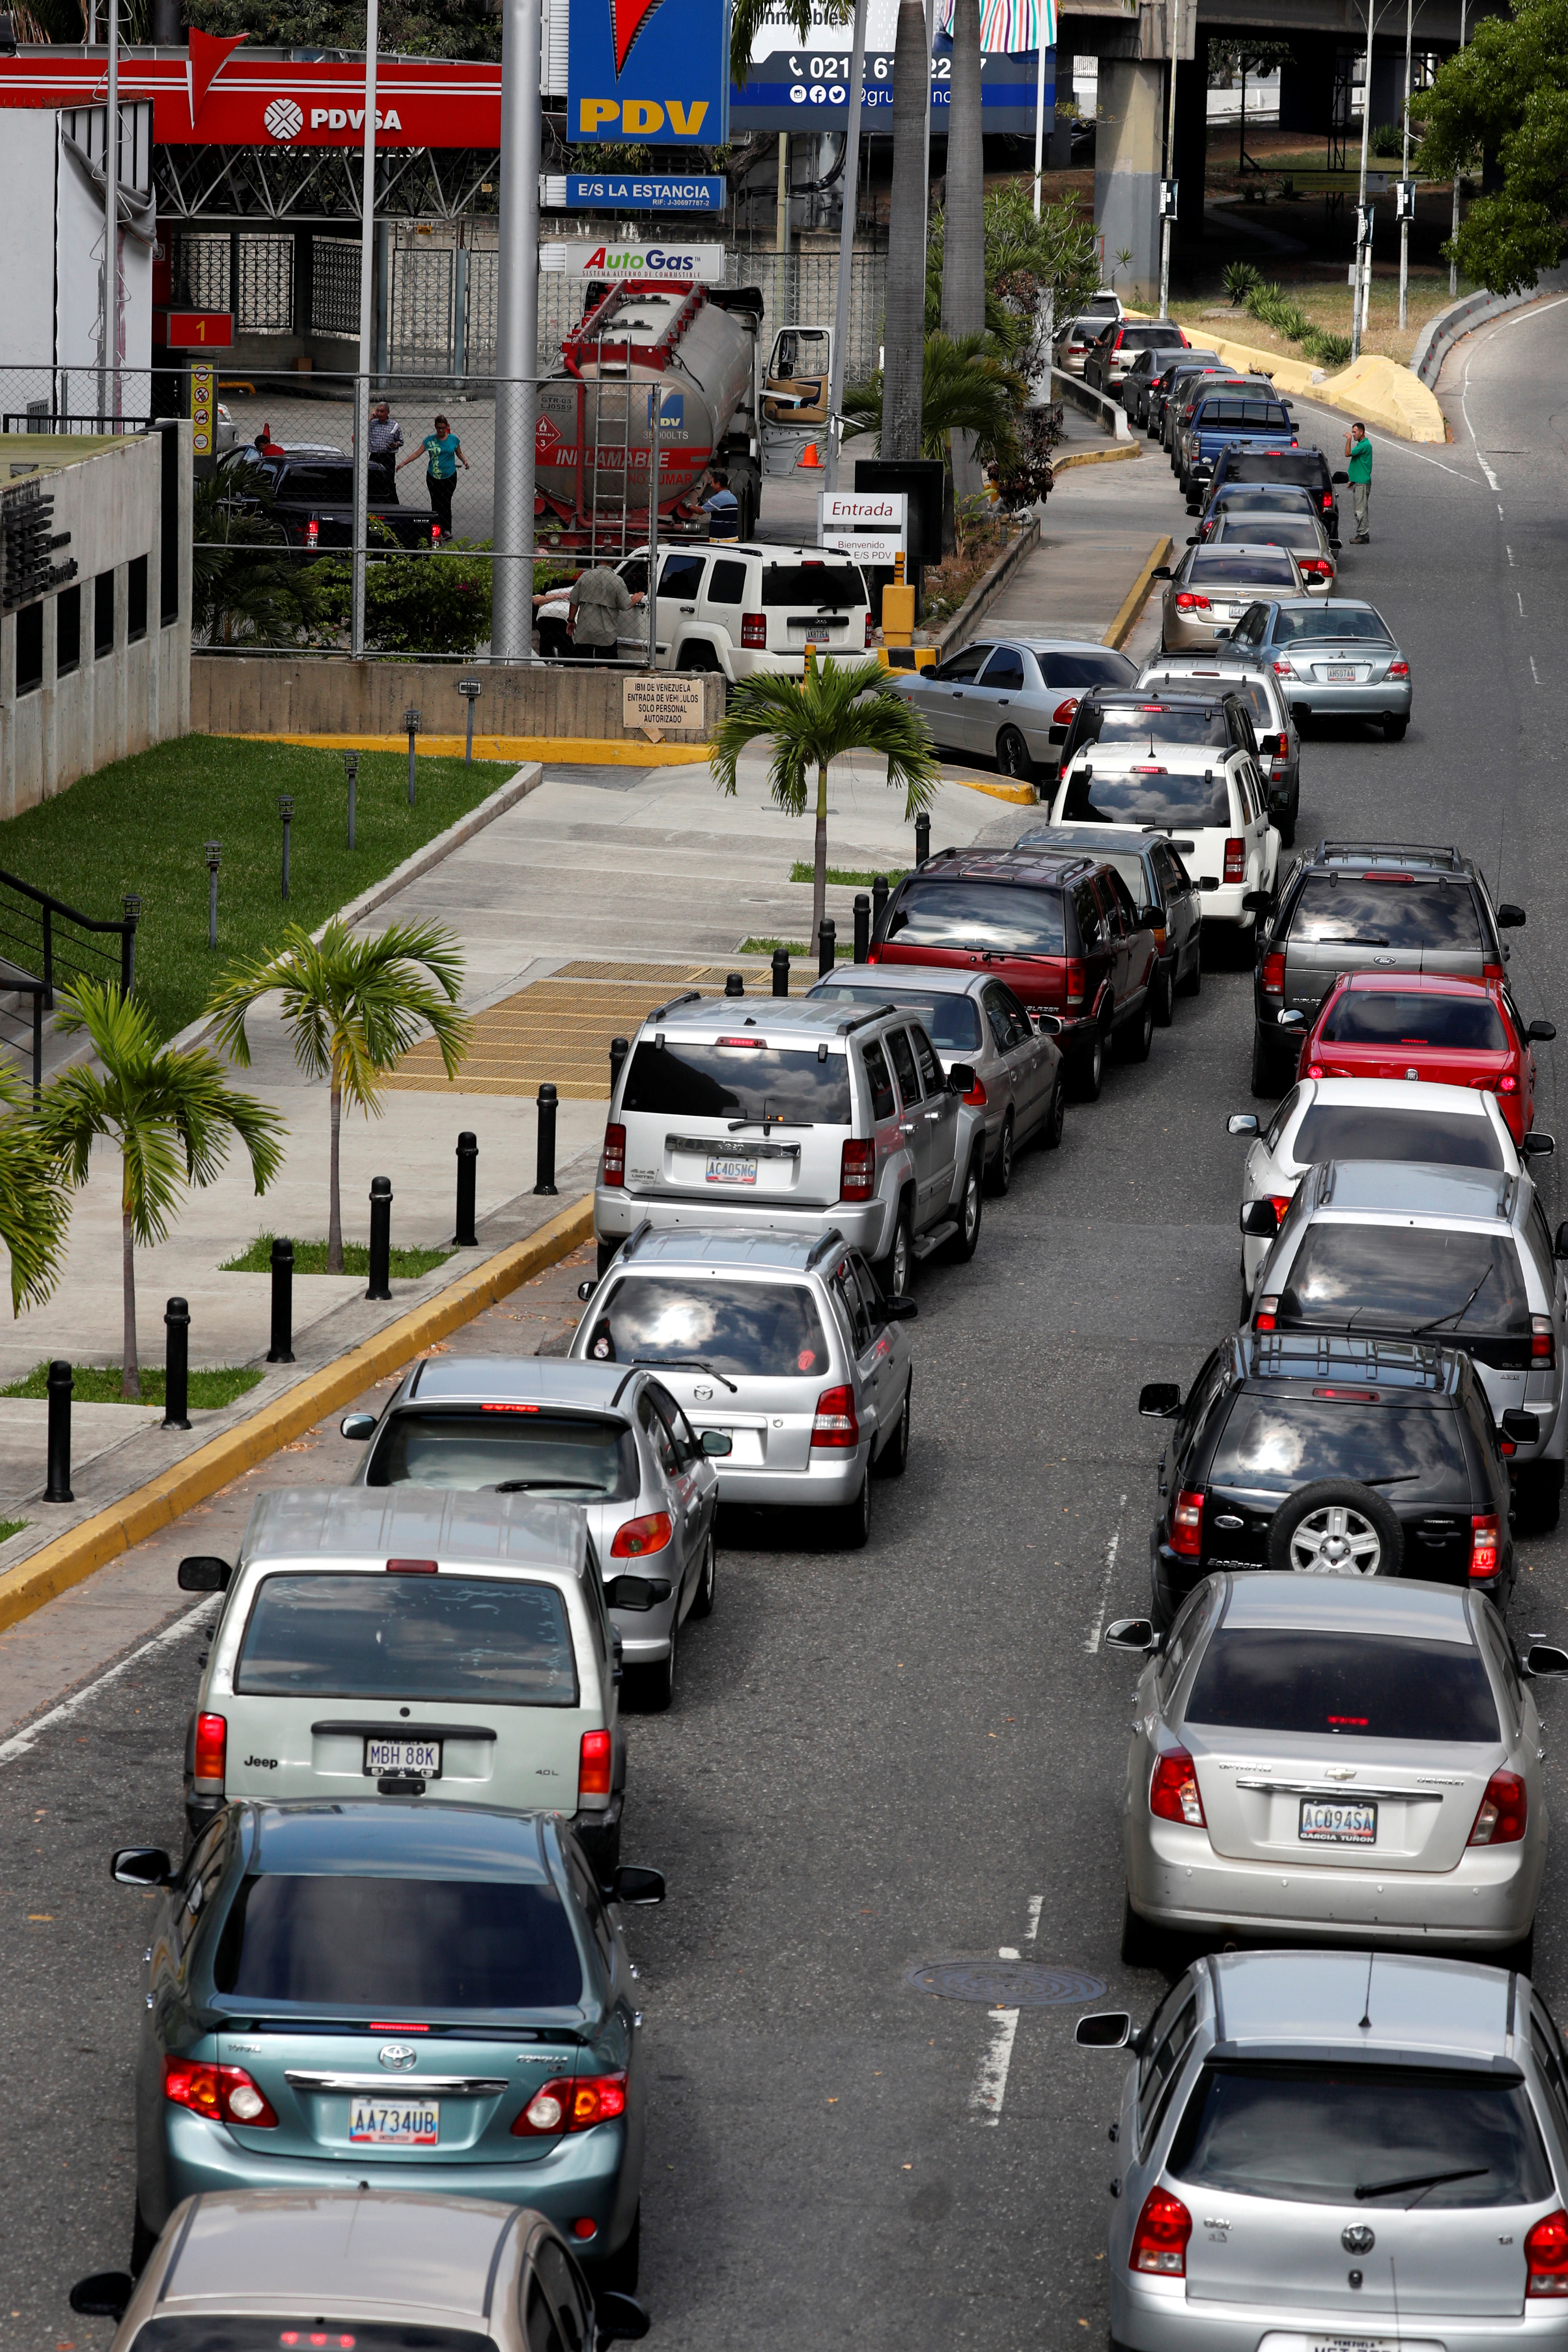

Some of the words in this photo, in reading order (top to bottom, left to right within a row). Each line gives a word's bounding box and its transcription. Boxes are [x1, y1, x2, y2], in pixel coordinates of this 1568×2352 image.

[760, 9, 849, 26] nmbles
[810, 57, 866, 78] 021
[579, 99, 709, 135] PDV
[578, 184, 604, 196] E/S
[608, 184, 628, 197] LA
[633, 185, 710, 198] ESTANCIA
[196, 320, 205, 341] 1
[650, 418, 681, 426] DV
[643, 431, 689, 439] 3800LTS
[628, 473, 646, 484] NO
[658, 473, 692, 485] UMAR
[832, 502, 893, 516] Entrada
[838, 541, 885, 549] Bienvenido
[1329, 669, 1354, 677] AH507AA
[635, 683, 646, 691] IBM
[656, 684, 691, 692] VENEZUELA
[627, 693, 655, 702] ENTRADA
[656, 694, 664, 702] DE
[639, 704, 655, 712] SOLO
[656, 704, 687, 713] PERSONAL
[644, 715, 682, 723] AUTORIZADO
[718, 1142, 744, 1151] Jeep
[708, 1161, 754, 1177] AC405NG
[370, 1746, 400, 1764] MBH
[405, 1747, 434, 1766] 88K
[244, 1755, 278, 1769] Jeep
[1417, 1777, 1466, 1787] CHEVROLET
[1304, 1808, 1372, 1831] AC094SA
[1300, 1832, 1337, 1840] GARCIA
[227, 2043, 261, 2053] TOYOTA
[516, 2055, 568, 2063] COROLLA
[355, 2109, 434, 2133] AA734UB
